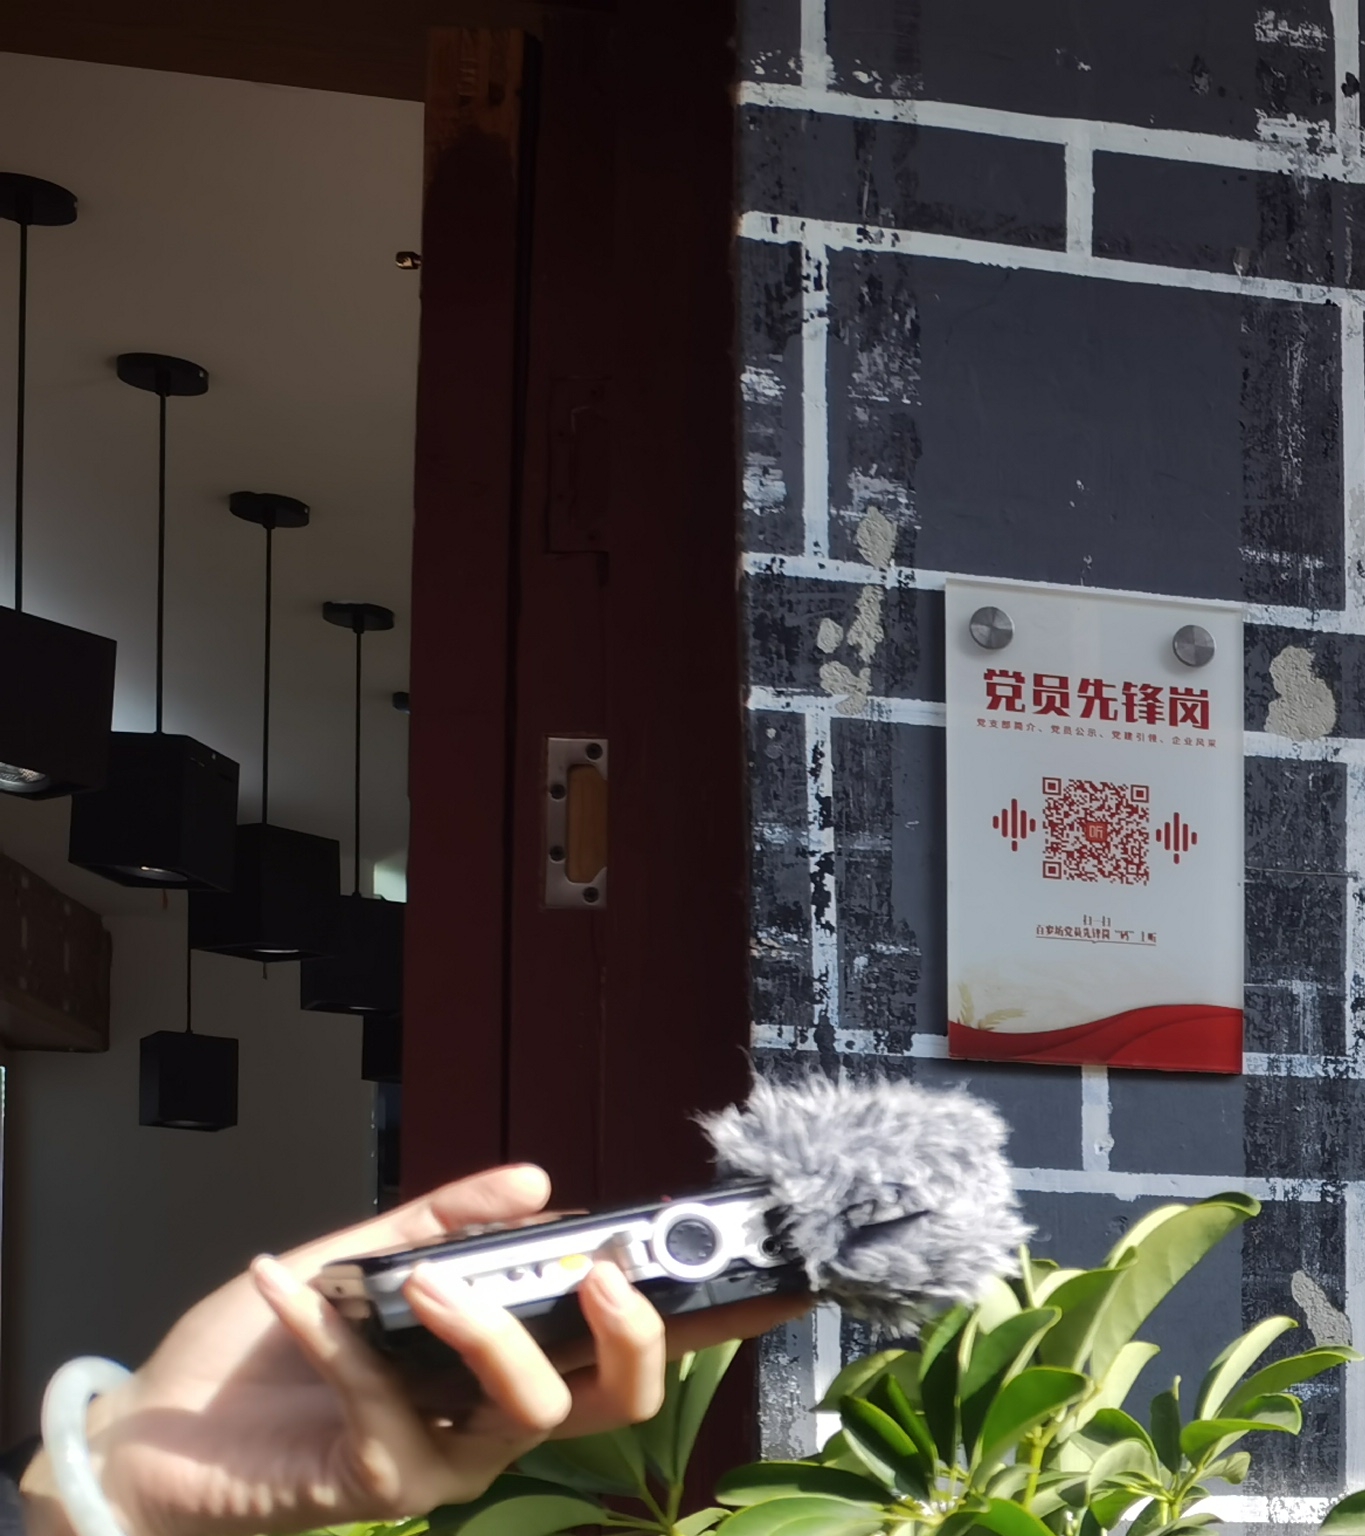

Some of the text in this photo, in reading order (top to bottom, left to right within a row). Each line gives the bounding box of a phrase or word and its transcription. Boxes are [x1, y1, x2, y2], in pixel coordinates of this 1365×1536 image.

[983, 668, 1210, 730] 党员先锋岗
